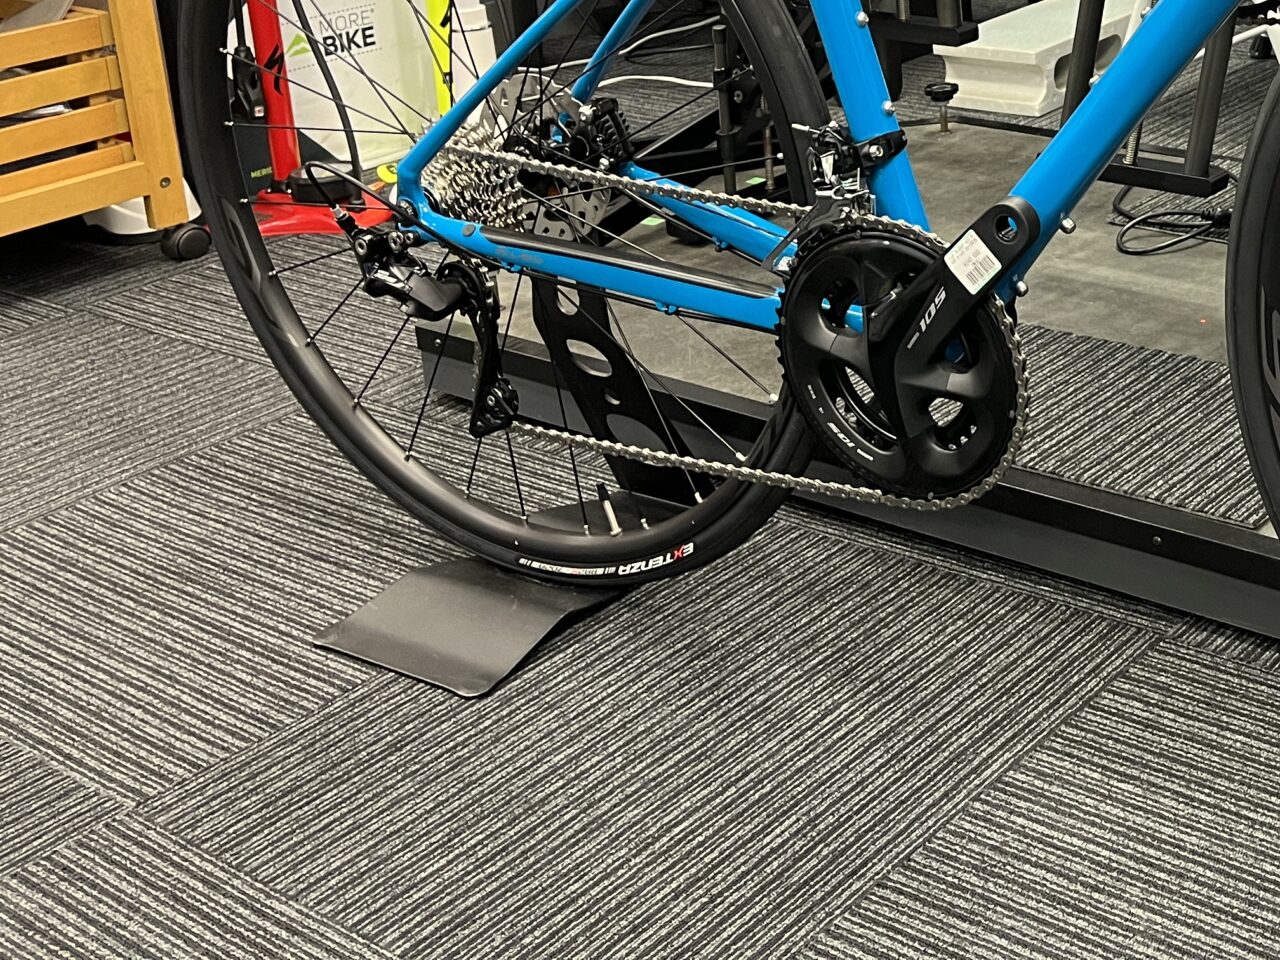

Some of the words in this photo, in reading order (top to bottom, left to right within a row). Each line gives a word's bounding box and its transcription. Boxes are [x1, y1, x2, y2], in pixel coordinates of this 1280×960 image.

[322, 26, 376, 57] BIKE
[919, 286, 946, 333] 105
[617, 542, 694, 576] EXTENZA
